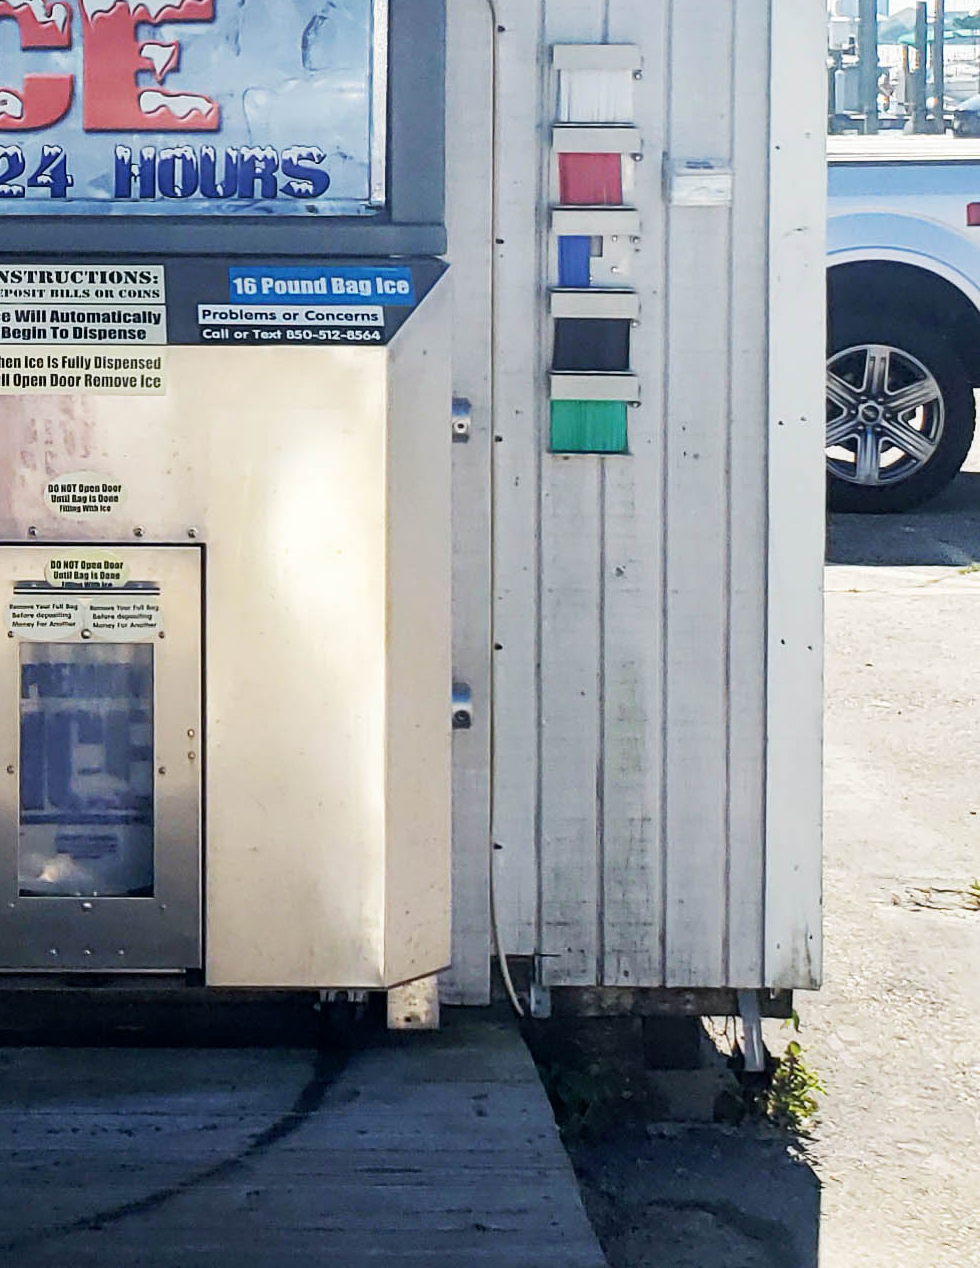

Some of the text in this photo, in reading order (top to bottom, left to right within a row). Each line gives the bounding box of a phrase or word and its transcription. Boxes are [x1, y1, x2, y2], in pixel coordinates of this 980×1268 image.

[114, 145, 331, 198] HOURS
[50, 289, 90, 298] BILLS
[95, 289, 115, 298] OR
[119, 289, 160, 298] COINS
[233, 277, 410, 296] 16 Pound Bag Ice
[15, 310, 46, 323] Will
[50, 311, 161, 325] Automatically
[202, 309, 379, 322] Problems or Concerns
[1, 327, 147, 341] Begin To Dispense
[202, 329, 229, 340] Call
[234, 331, 249, 340] or
[252, 330, 282, 340] Text
[24, 356, 44, 369] Ice
[61, 356, 92, 370] Fully
[94, 356, 162, 371] Dispensed
[13, 374, 47, 389] Open
[50, 374, 81, 388] Door
[84, 374, 137, 388] Remove
[140, 374, 162, 388] Ice
[48, 484, 122, 493] DO NOT Open Door
[50, 560, 124, 570] DO NOT Open Door
